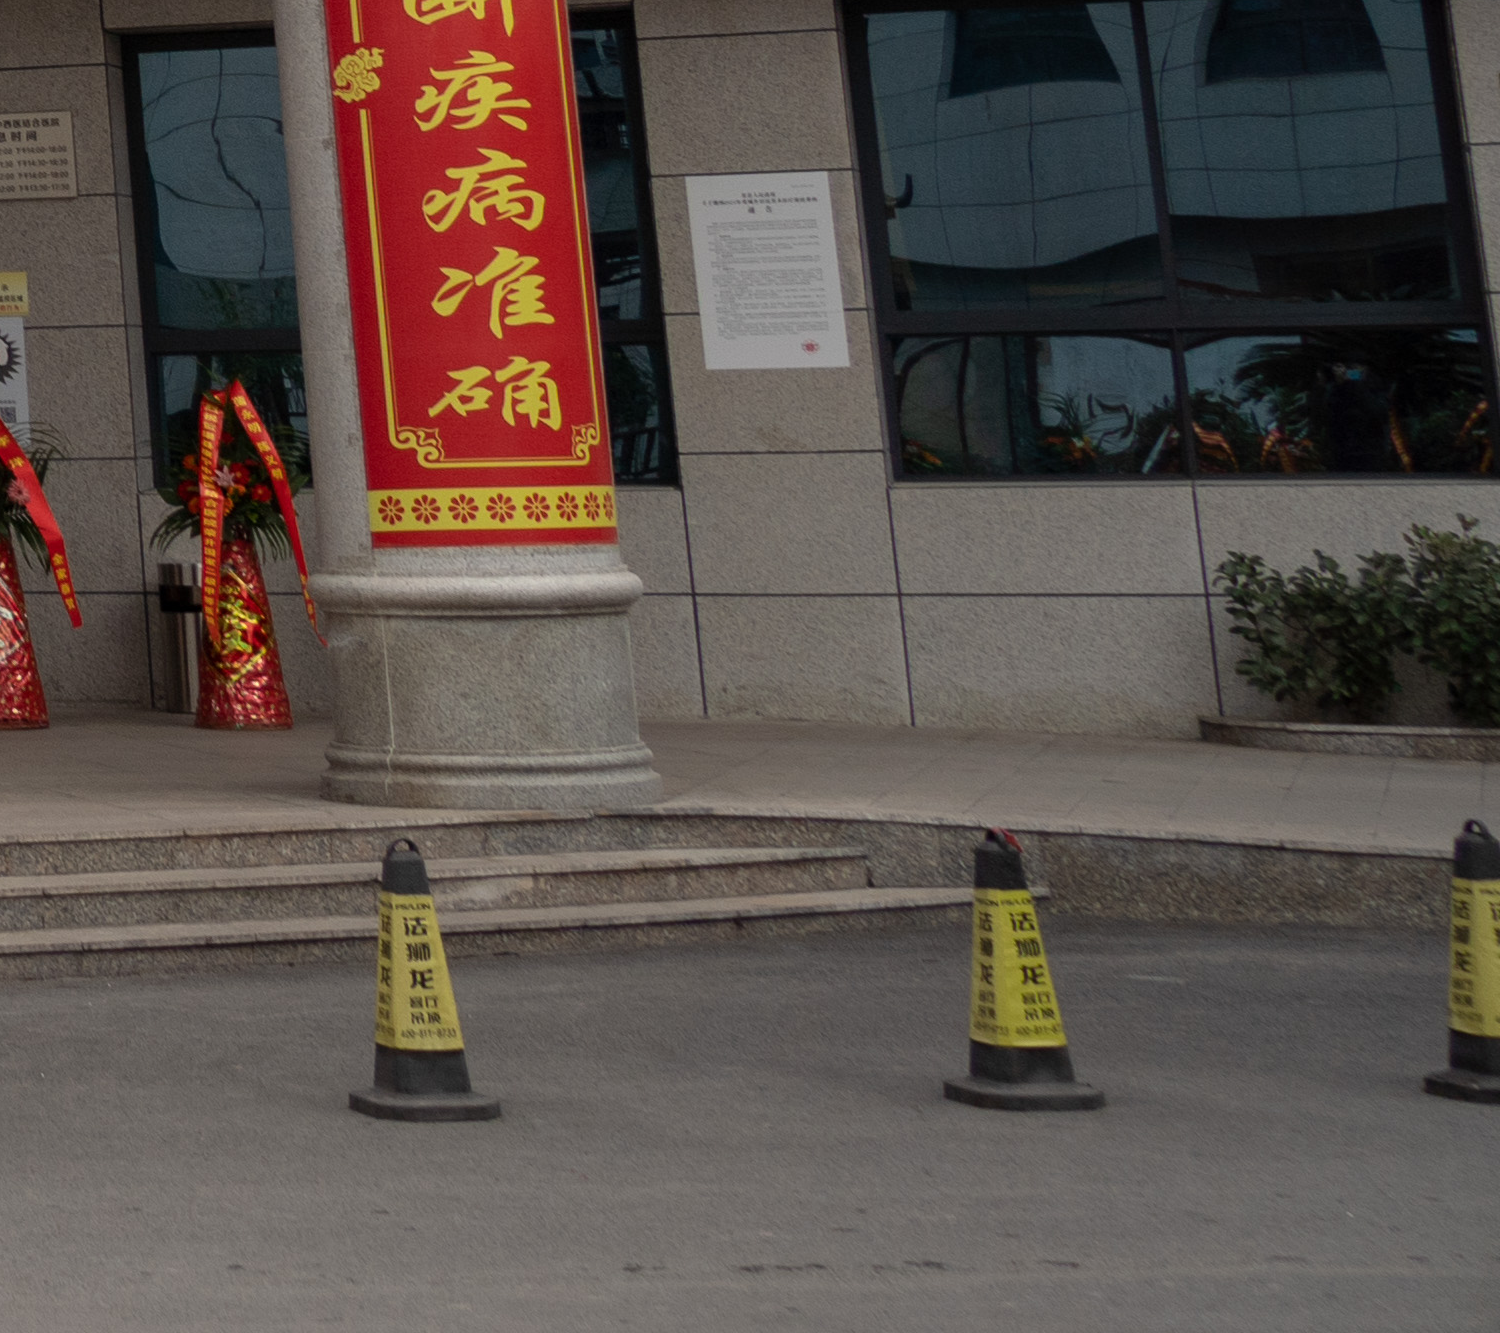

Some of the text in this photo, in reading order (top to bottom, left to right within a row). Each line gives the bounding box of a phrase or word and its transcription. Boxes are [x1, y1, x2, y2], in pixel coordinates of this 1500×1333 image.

[403, 916, 434, 990] 法狮龙
[1008, 911, 1047, 985] 法狮龙
